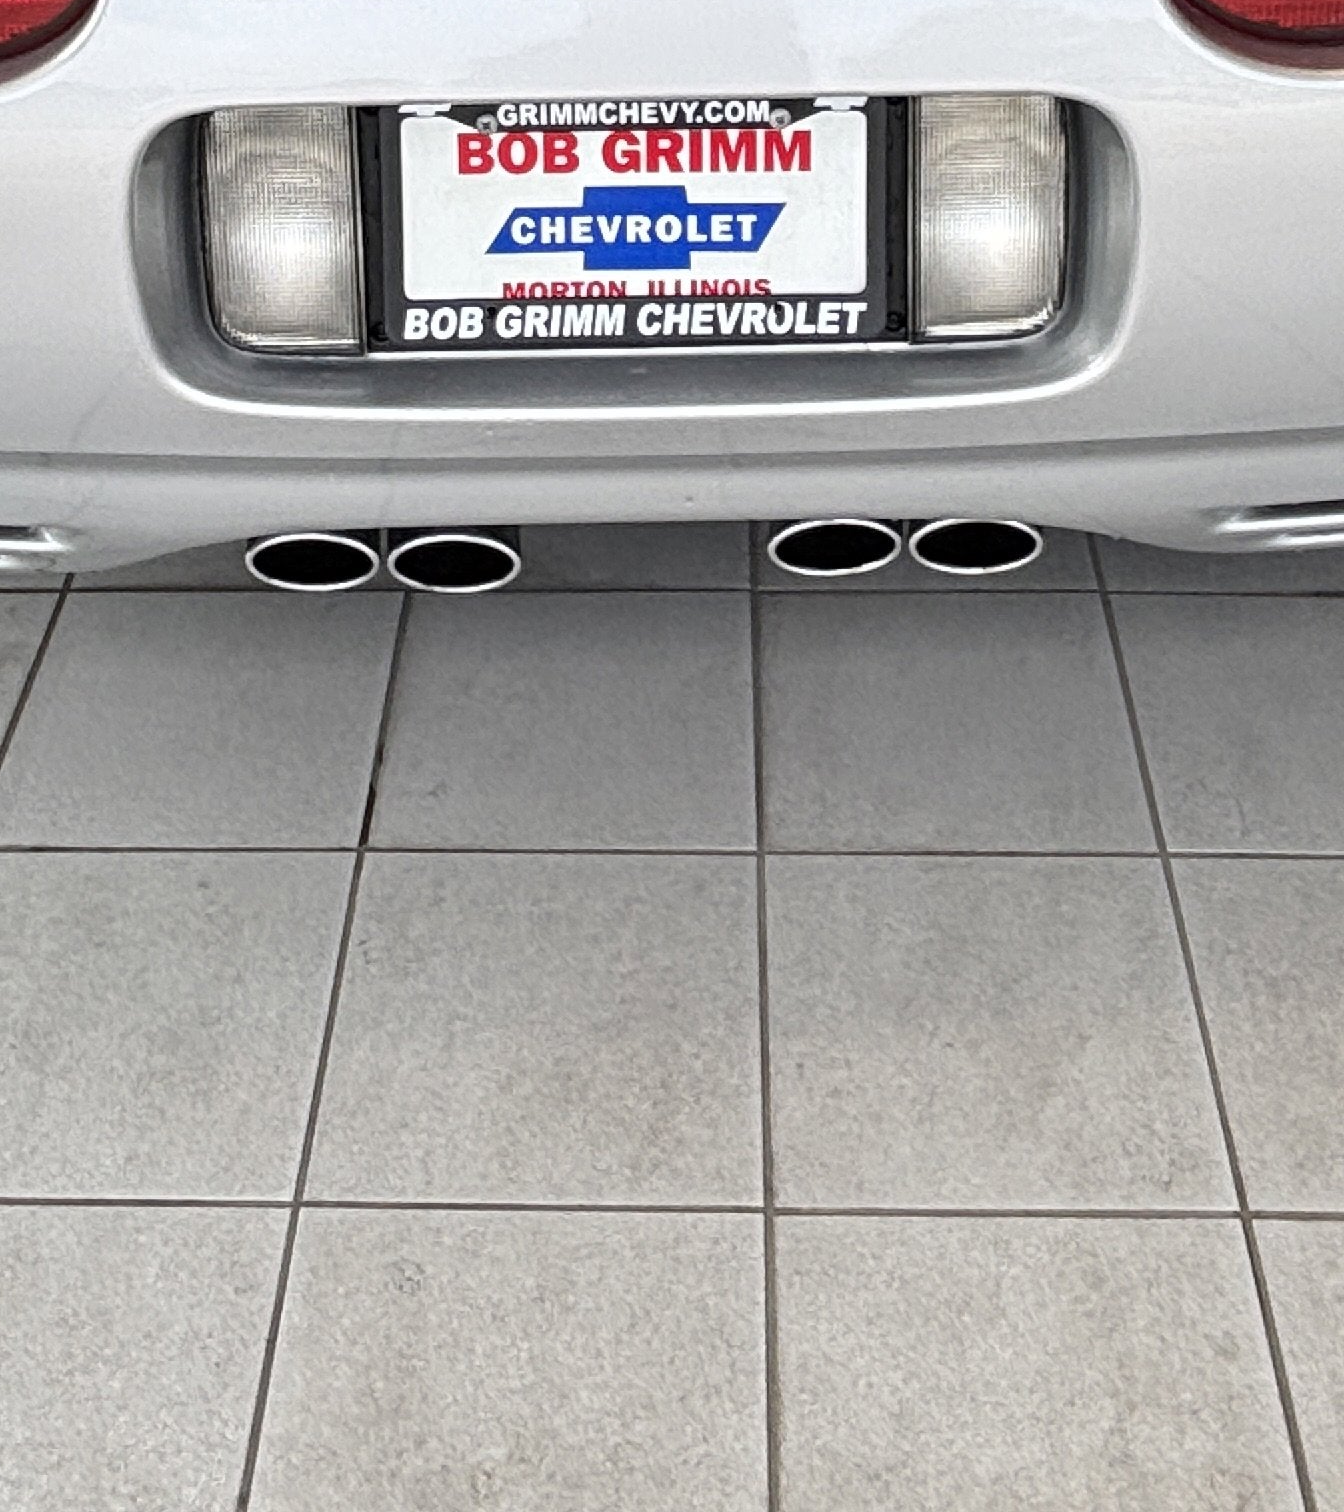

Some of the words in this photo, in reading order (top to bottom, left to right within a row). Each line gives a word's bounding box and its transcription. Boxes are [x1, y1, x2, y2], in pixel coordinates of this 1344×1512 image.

[496, 100, 771, 128] GRIMMCHEVY.COM
[457, 130, 580, 175] BOB
[602, 129, 812, 173] GRIMM
[511, 213, 758, 245] CHEVROLET
[502, 280, 627, 299] MORTON
[647, 277, 773, 298] ILLINOIS
[403, 306, 487, 340] BOB
[495, 303, 625, 339] GRIMM
[636, 301, 867, 337] CHEVROLET
